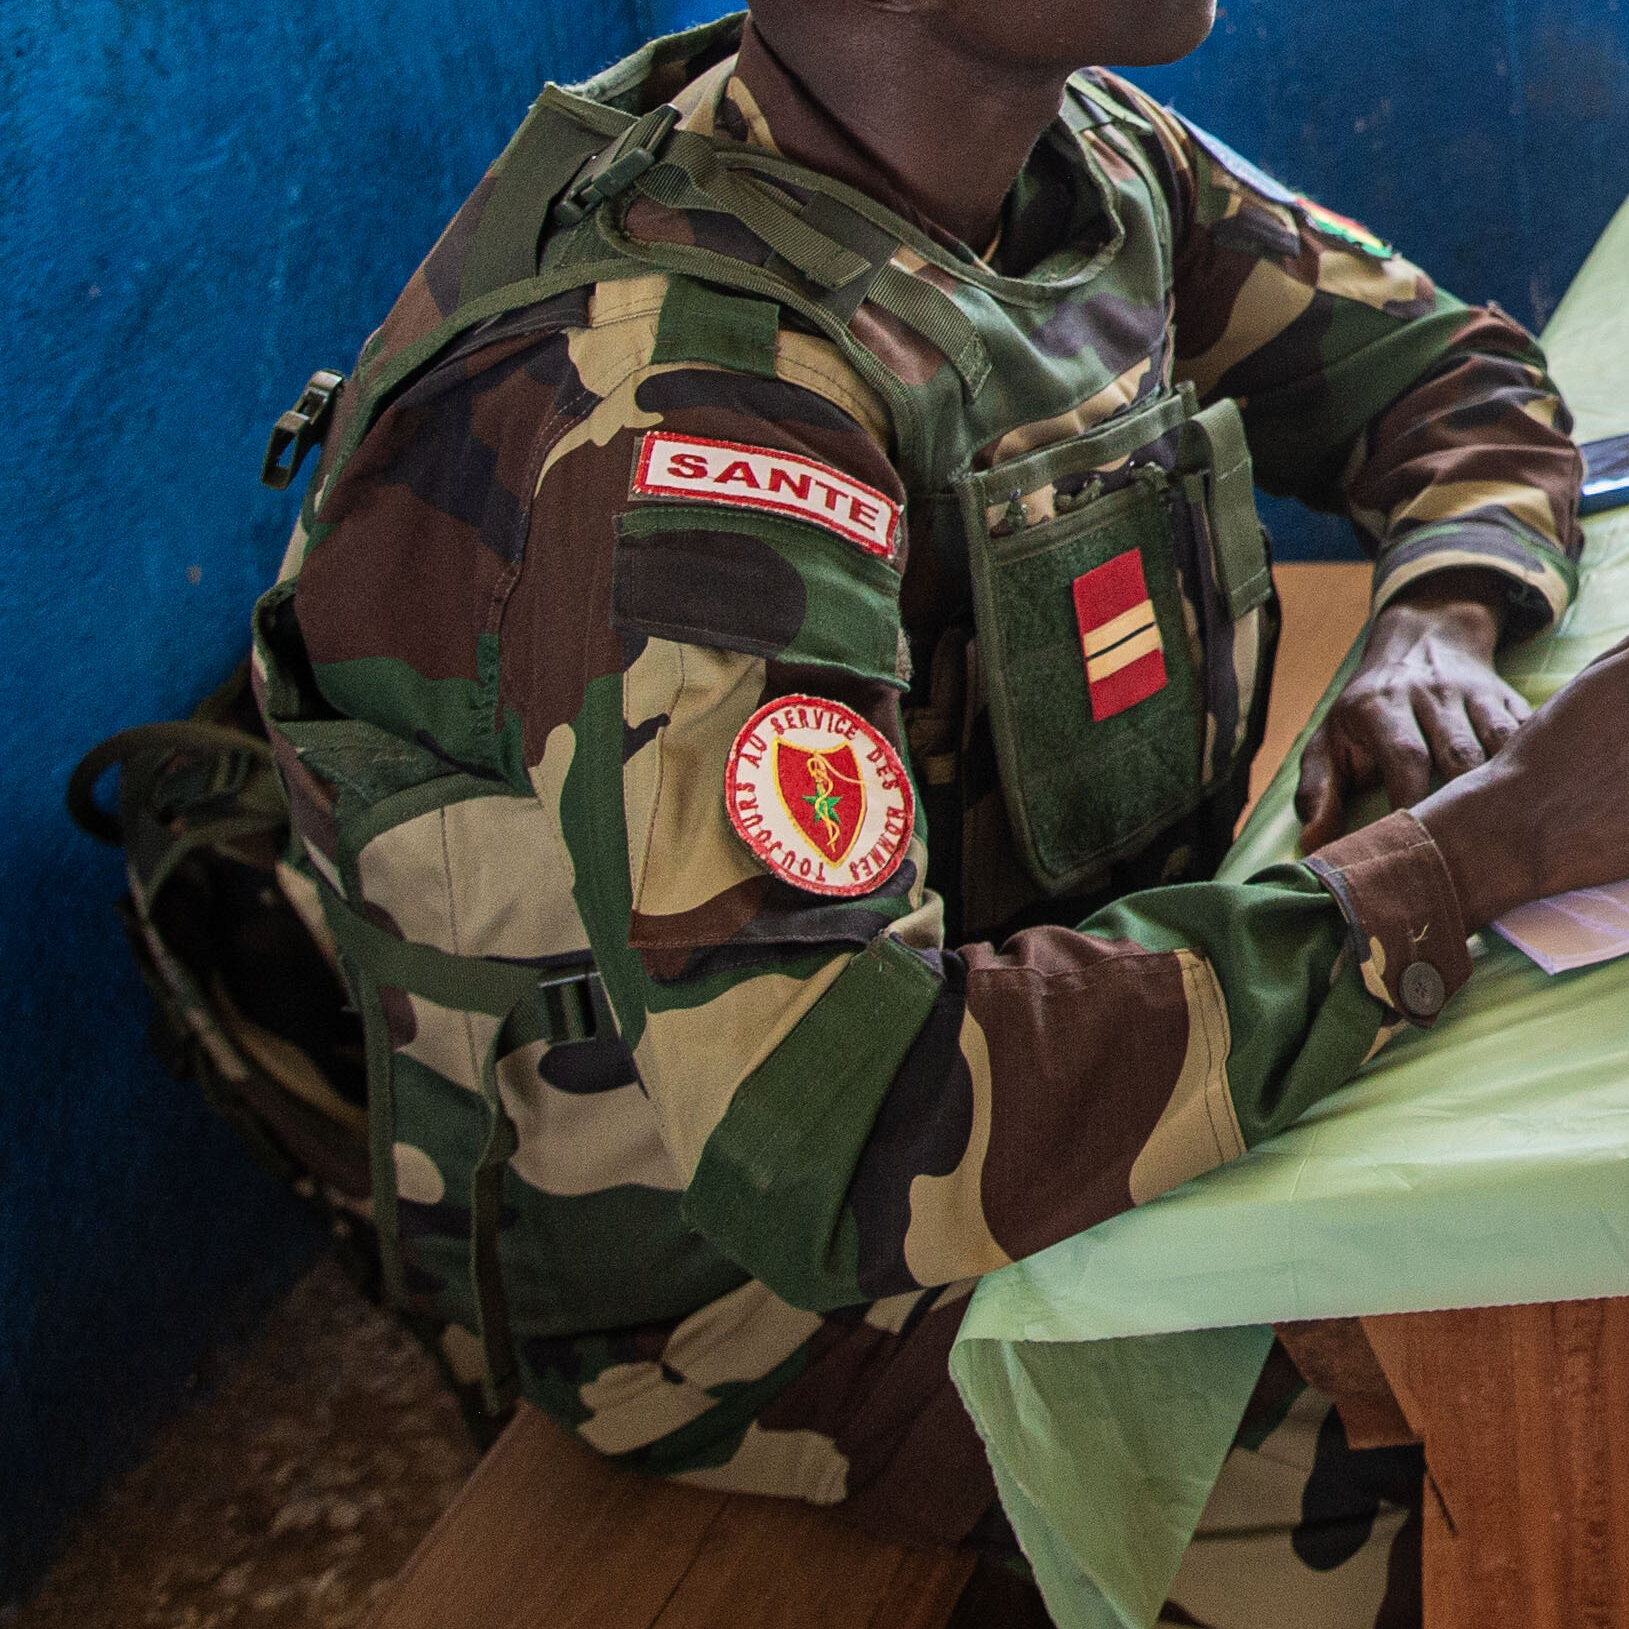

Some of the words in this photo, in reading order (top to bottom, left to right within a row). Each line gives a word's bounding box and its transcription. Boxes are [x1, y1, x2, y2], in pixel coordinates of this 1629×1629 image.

[667, 453, 880, 532] SANTE
[770, 708, 860, 741] SERVICE
[739, 731, 768, 770] AU
[865, 746, 900, 792] DES
[735, 781, 826, 883] TOUJOURS
